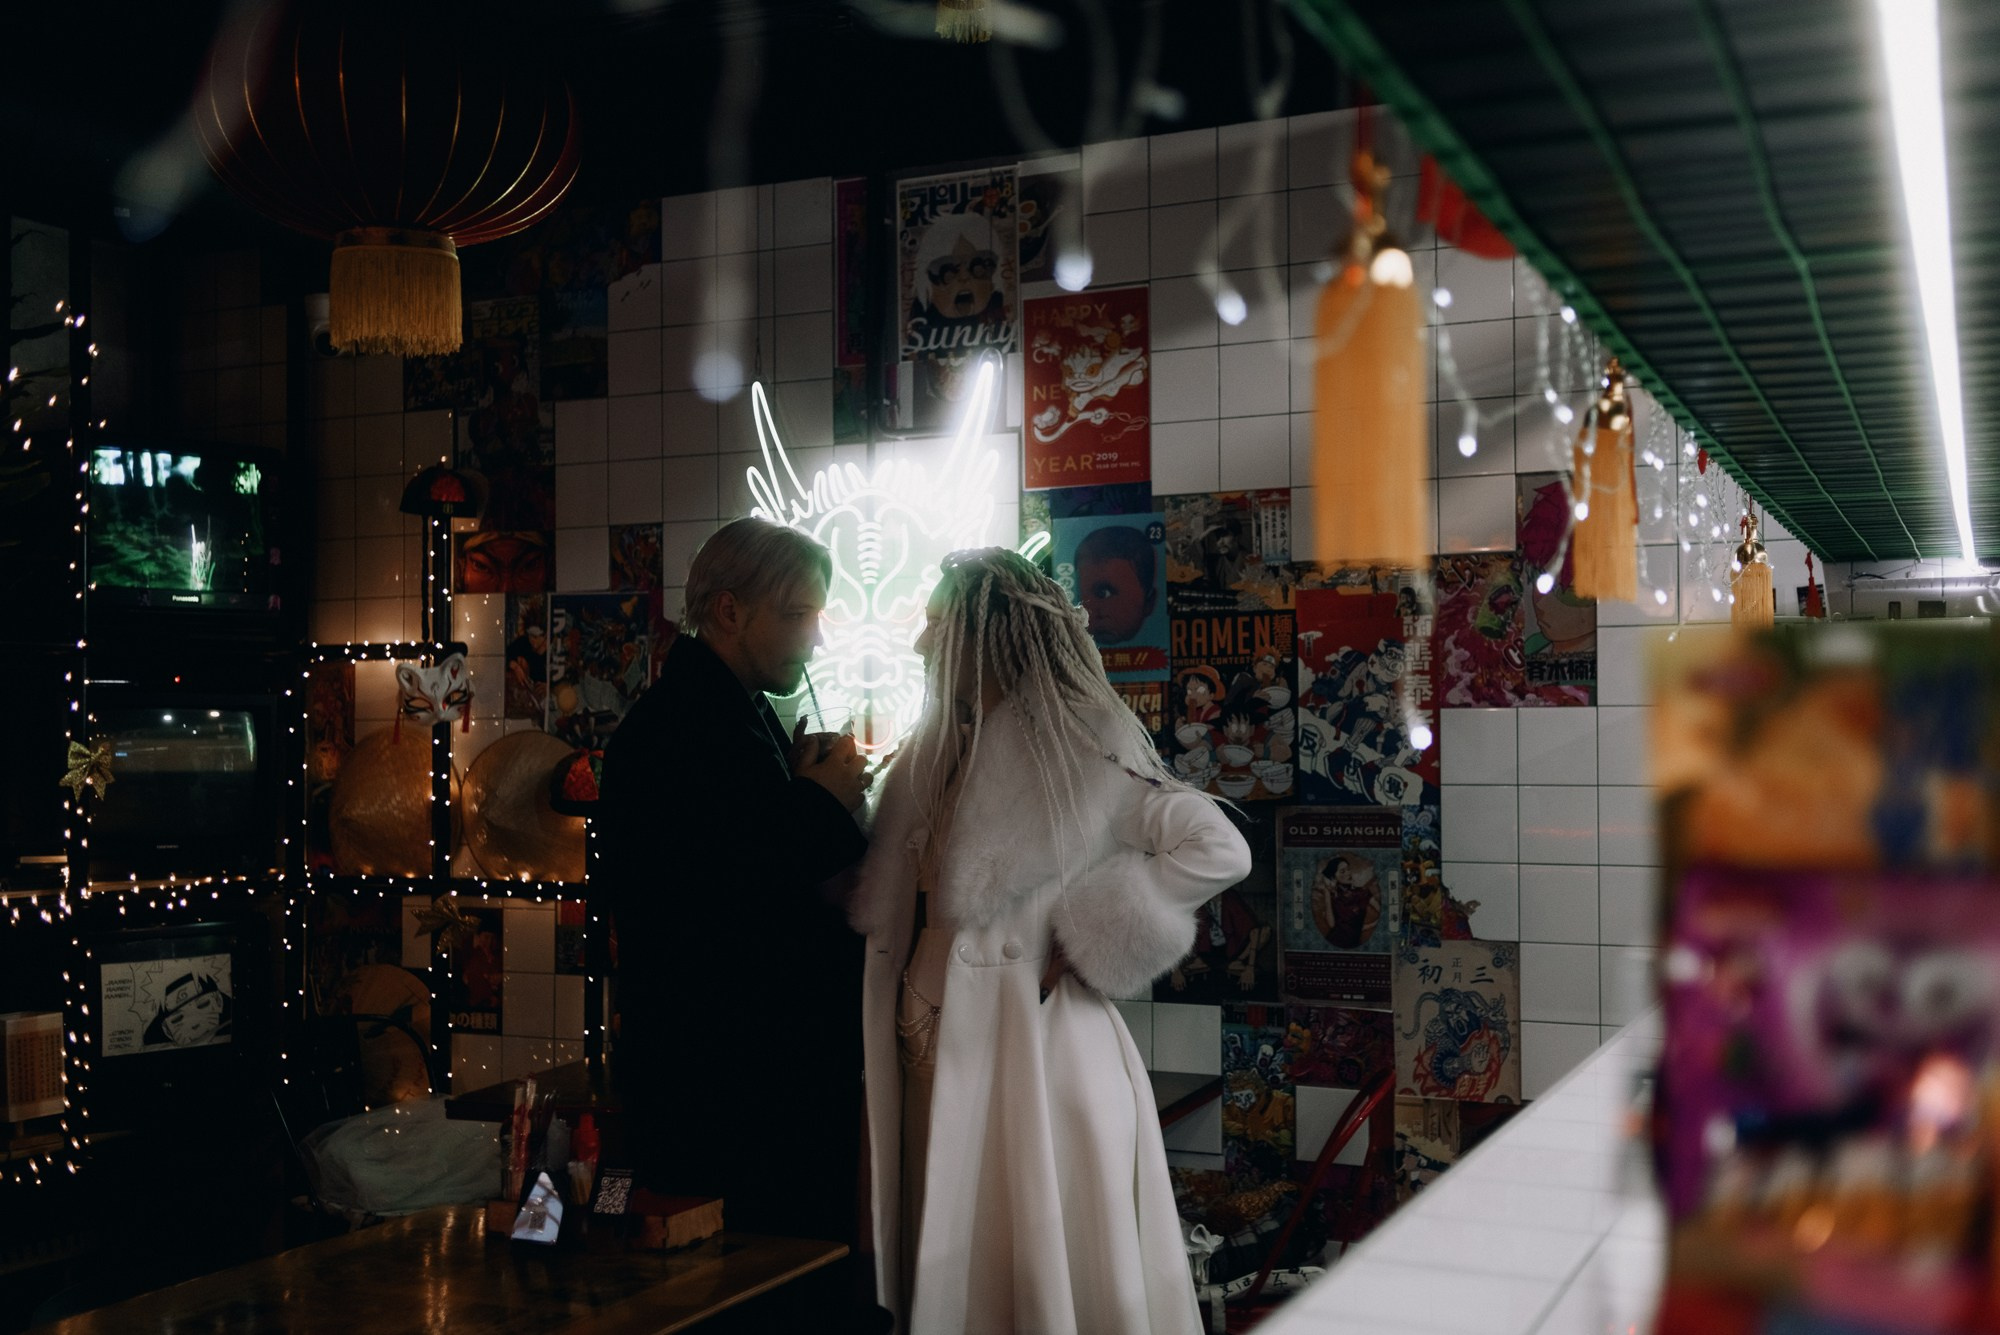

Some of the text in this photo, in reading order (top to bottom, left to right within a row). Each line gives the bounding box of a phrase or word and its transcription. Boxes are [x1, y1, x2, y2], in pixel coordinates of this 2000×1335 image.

[1032, 303, 1106, 326] HAPPY
[901, 317, 1018, 356] Sunny
[1033, 385, 1060, 402] NE
[1033, 454, 1094, 473] YEAR
[1096, 452, 1118, 463] 2019
[1149, 527, 1162, 540] 23
[1171, 615, 1271, 658] RAMEN
[1288, 825, 1401, 837] OLD SHANGHAI
[1418, 958, 1495, 985] 初 三
[1452, 957, 1463, 983] 正月
